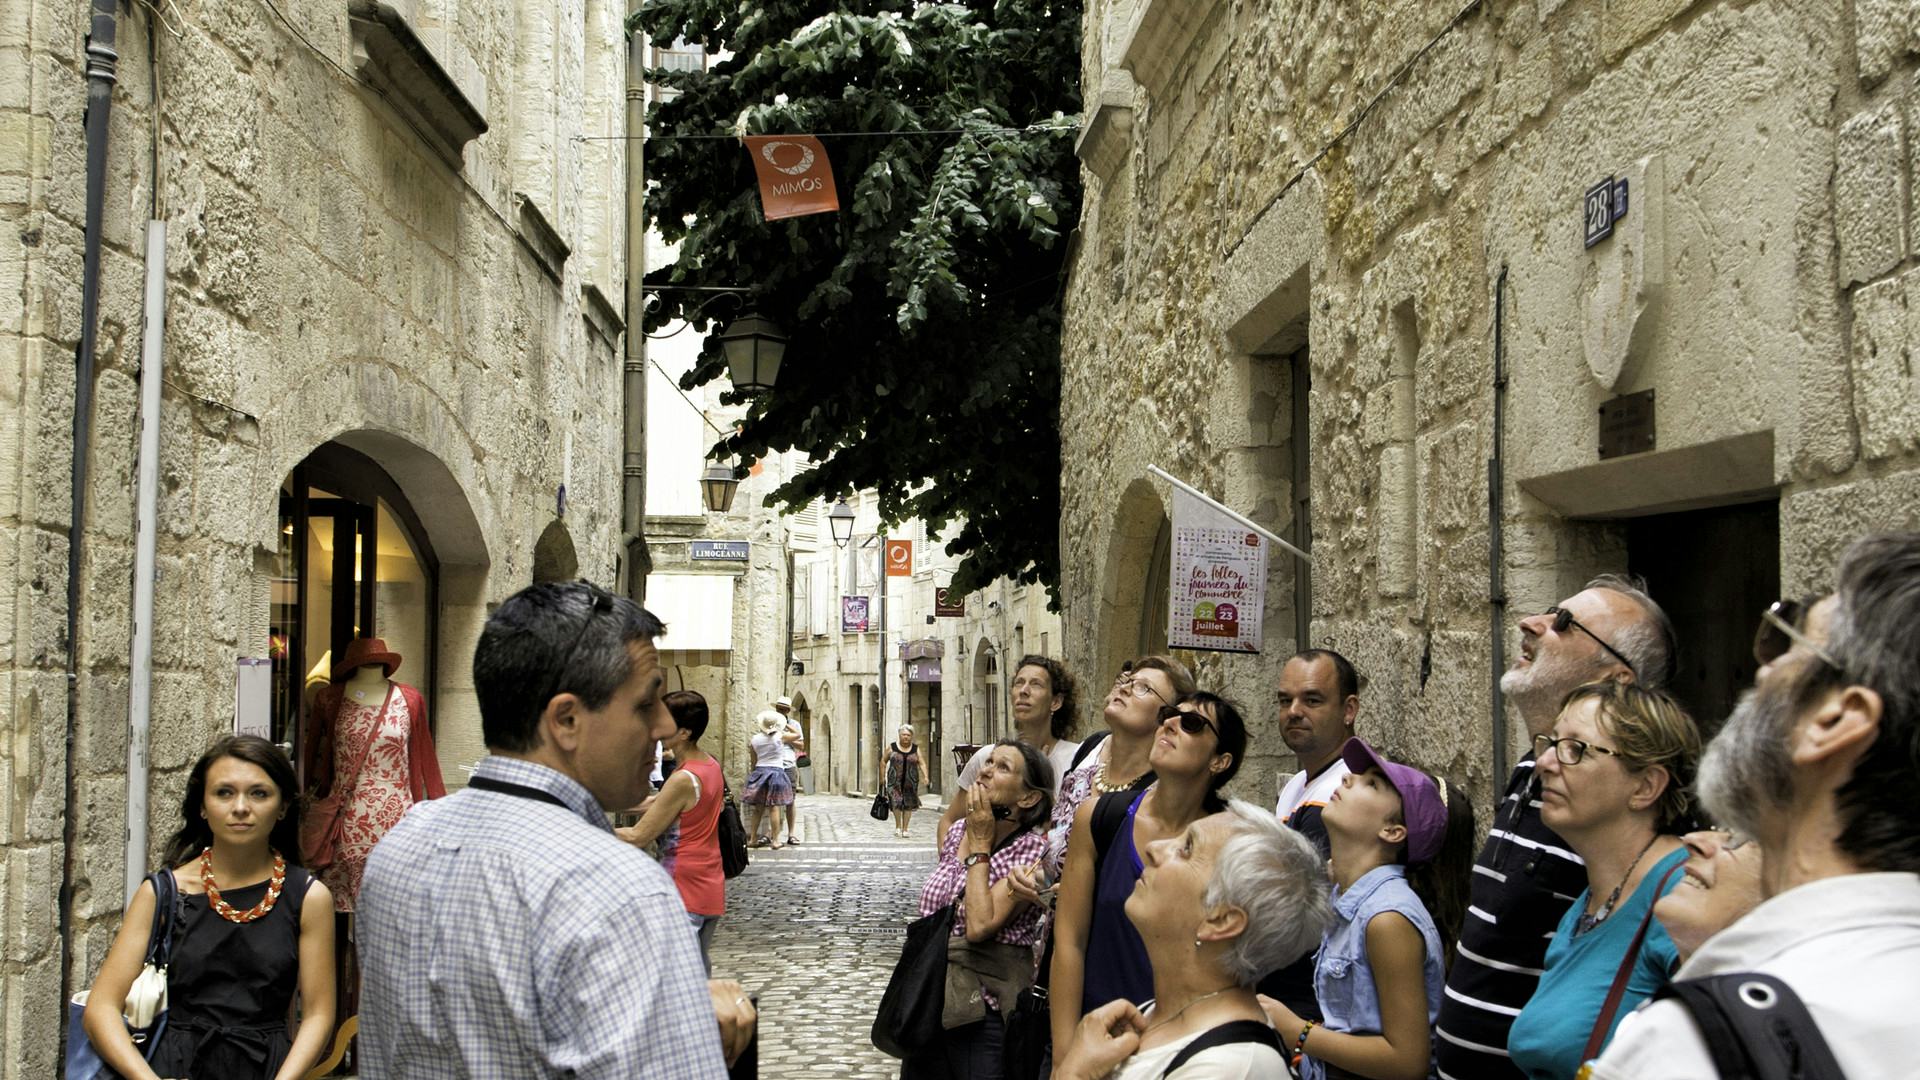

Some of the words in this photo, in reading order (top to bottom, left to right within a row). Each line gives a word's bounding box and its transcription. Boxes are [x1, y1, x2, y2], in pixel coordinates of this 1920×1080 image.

[772, 177, 823, 198] MIMOS
[1588, 189, 1608, 236] 28
[713, 542, 729, 550] RUE
[695, 550, 747, 558] LIMOGEANNE
[1192, 565, 1207, 579] les
[1211, 564, 1239, 580] folles
[1234, 576, 1249, 590] du
[1194, 590, 1244, 599] commerce
[1219, 611, 1233, 620] 23
[1195, 621, 1225, 631] juillet
